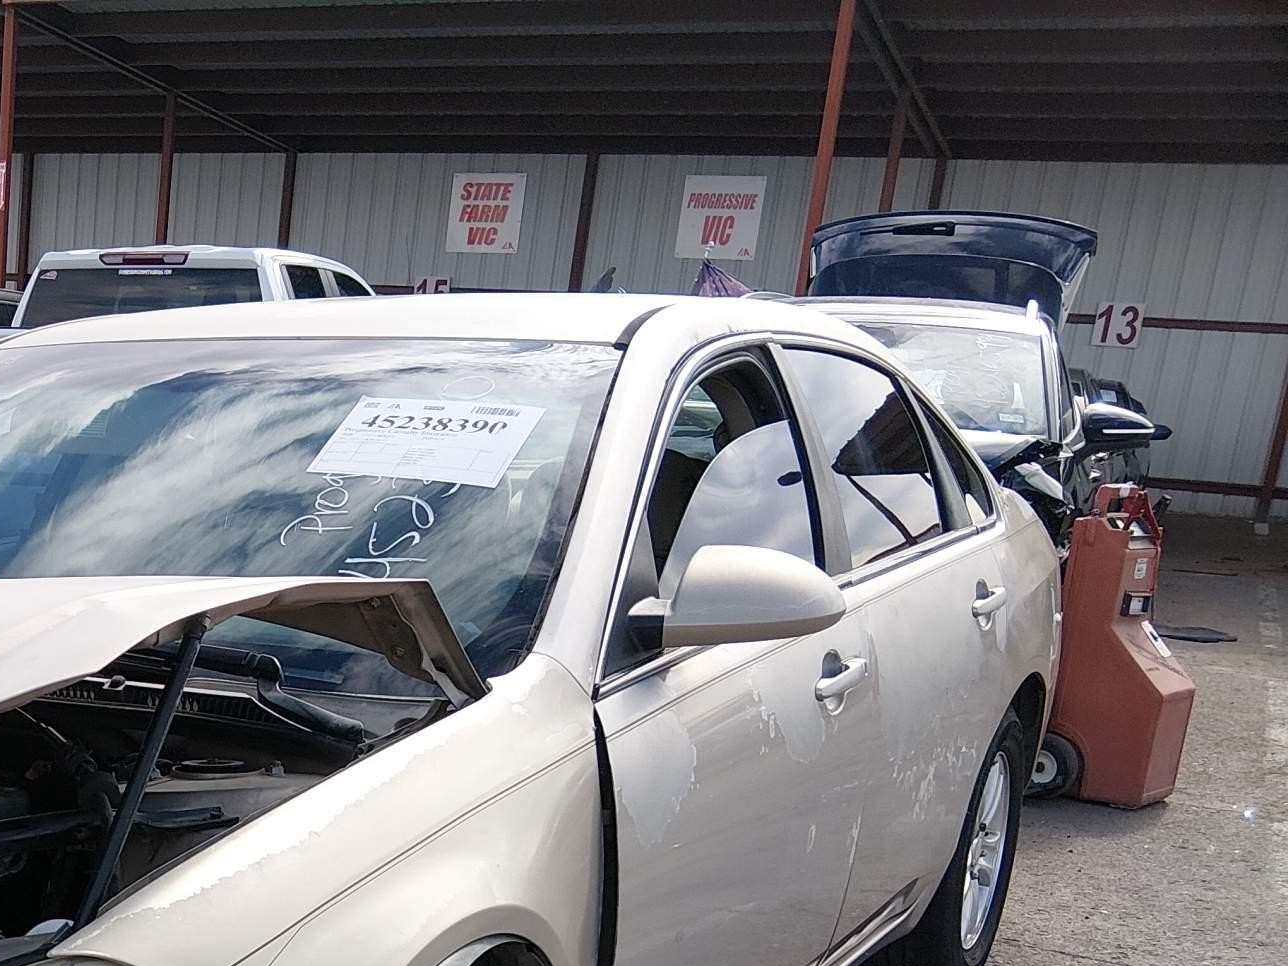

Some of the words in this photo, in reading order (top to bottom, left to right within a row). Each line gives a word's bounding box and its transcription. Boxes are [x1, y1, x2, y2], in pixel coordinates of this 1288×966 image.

[461, 182, 514, 201] STATE
[687, 192, 759, 210] PROGRESSIVE
[459, 204, 509, 223] FARM
[467, 226, 498, 246] VIC
[701, 215, 735, 246] VIC
[1097, 304, 1139, 345] 13
[361, 413, 508, 435] 45238390
